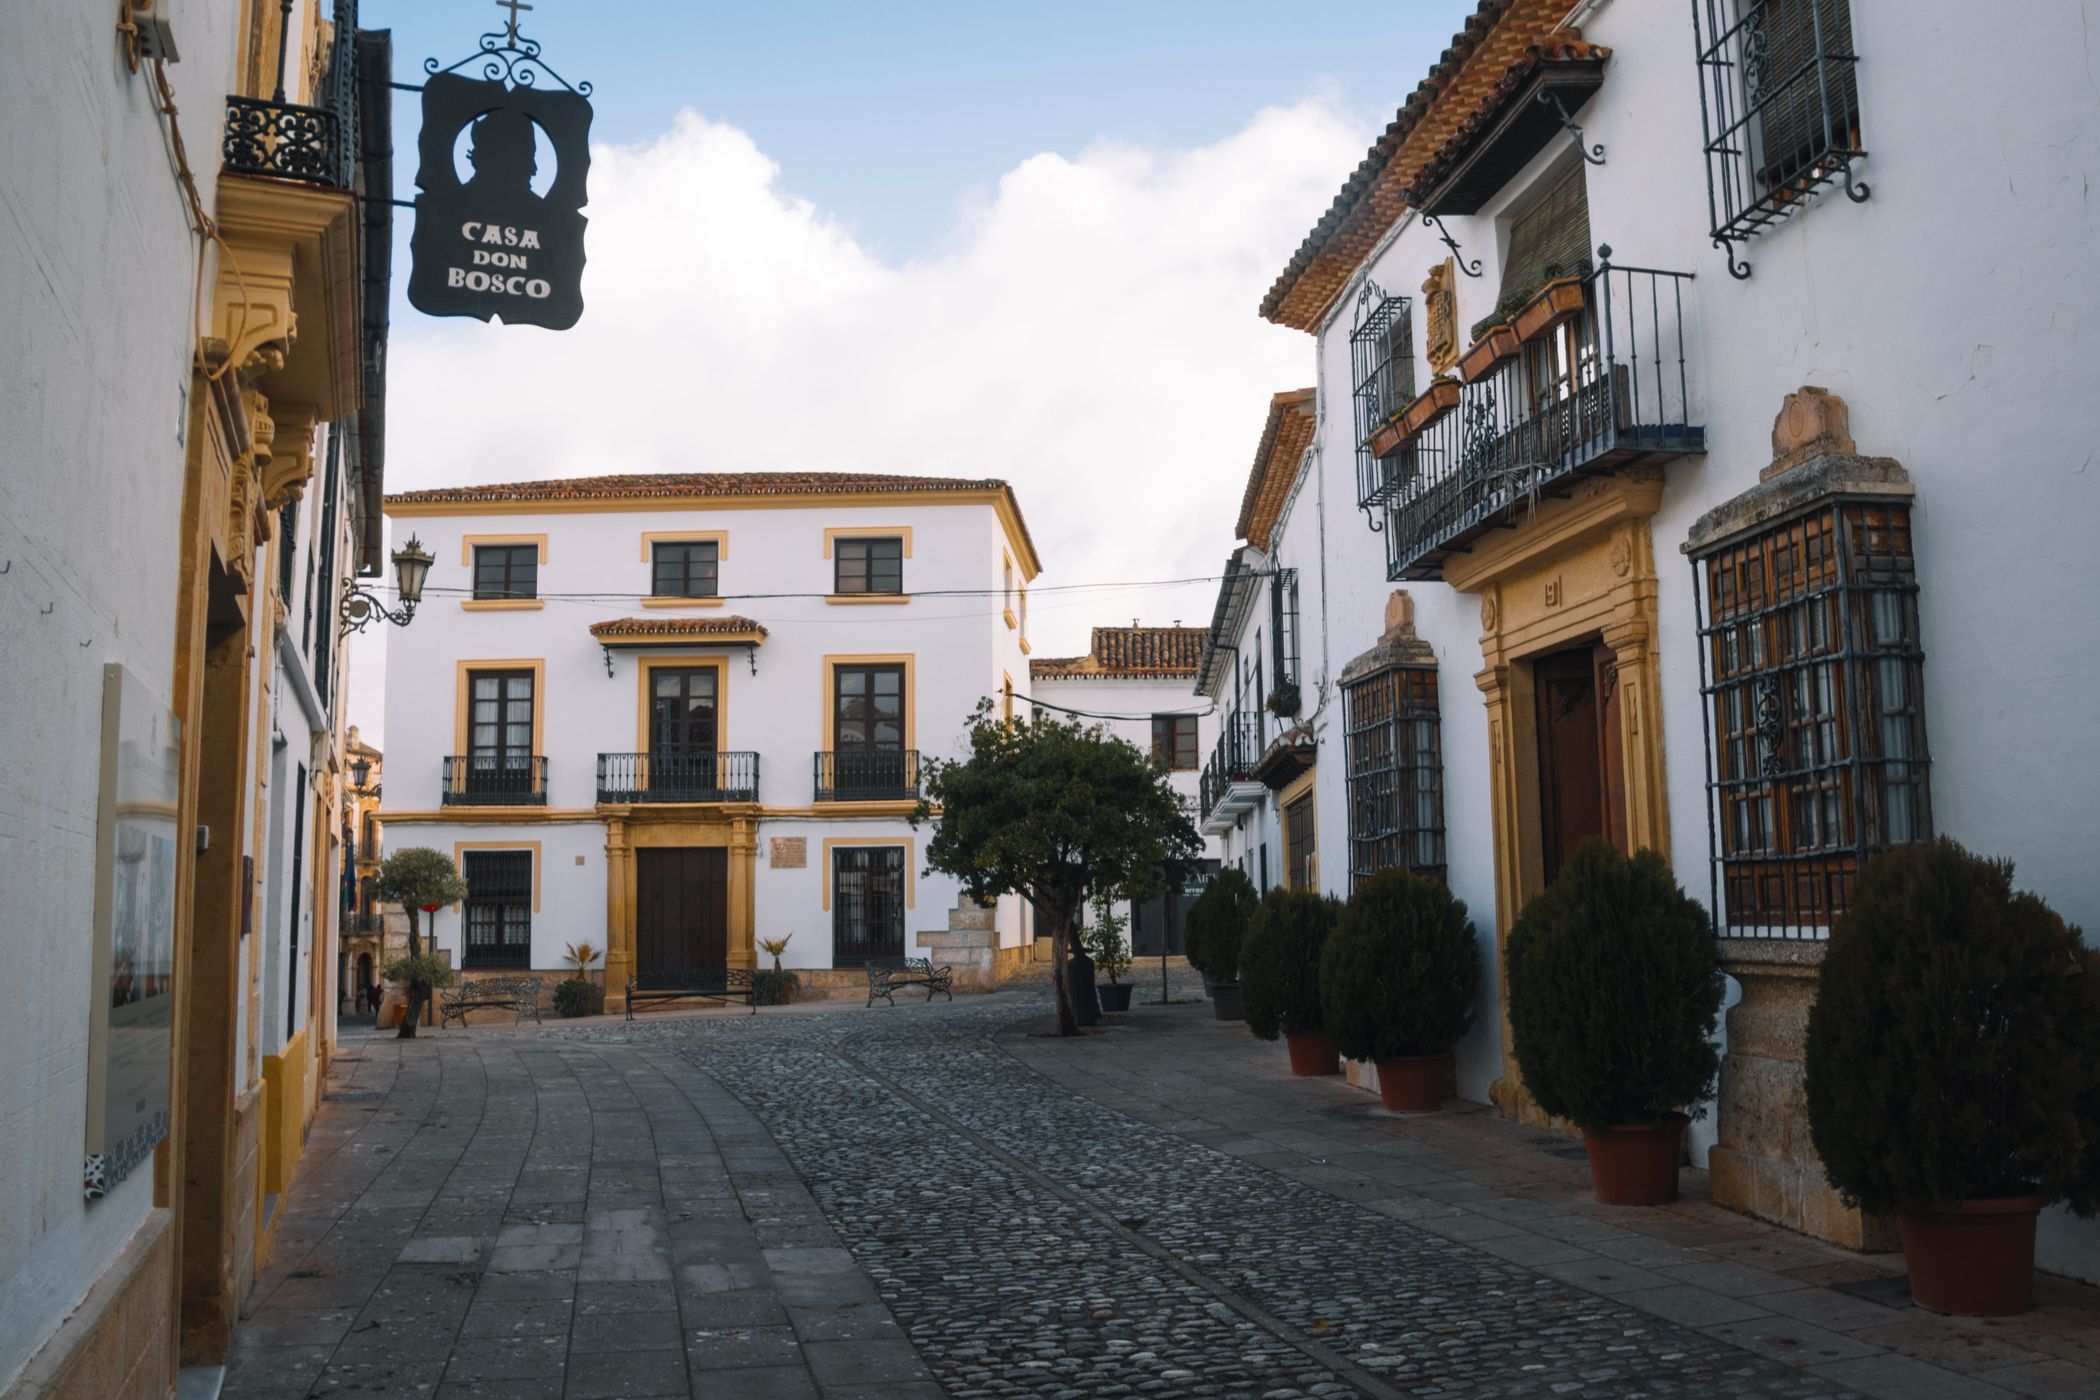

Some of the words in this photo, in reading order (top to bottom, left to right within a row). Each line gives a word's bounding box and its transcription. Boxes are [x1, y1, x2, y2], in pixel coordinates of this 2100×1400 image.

[461, 221, 541, 249] CASA
[473, 250, 528, 270] DON
[447, 267, 552, 299] BOSCO
